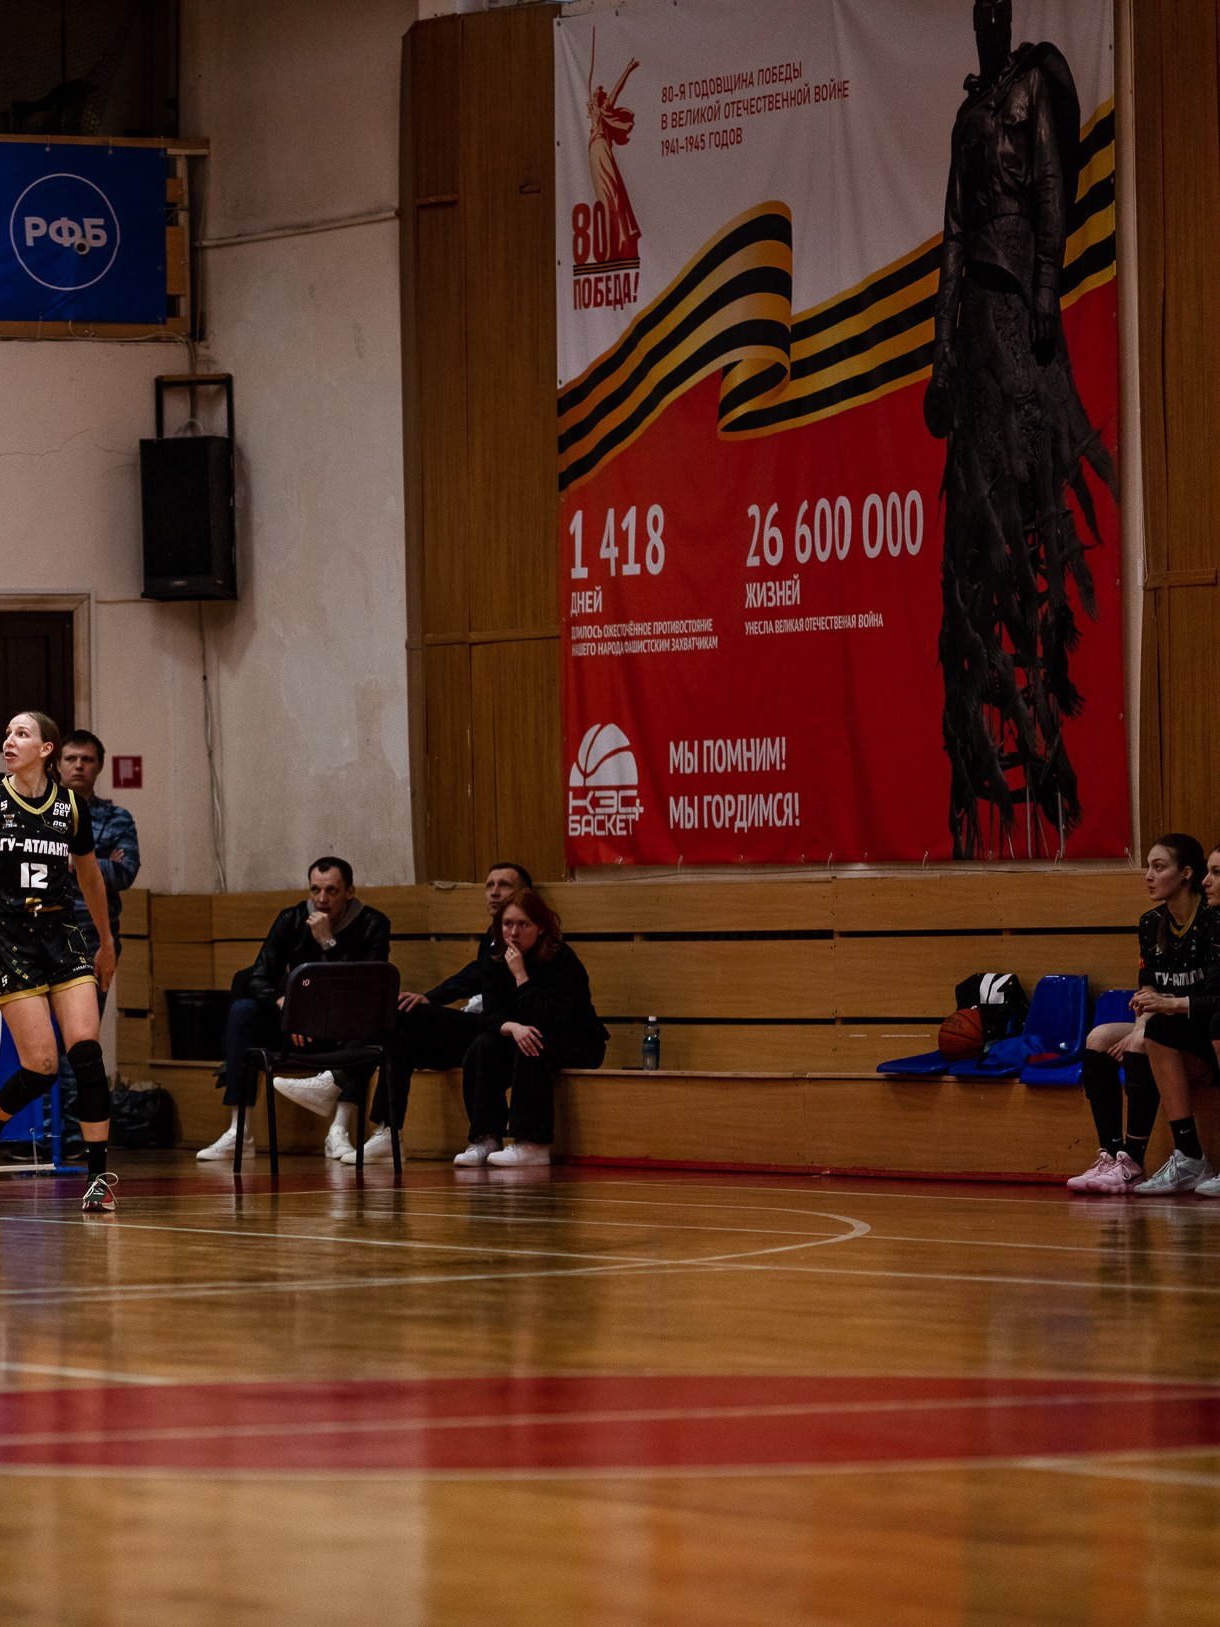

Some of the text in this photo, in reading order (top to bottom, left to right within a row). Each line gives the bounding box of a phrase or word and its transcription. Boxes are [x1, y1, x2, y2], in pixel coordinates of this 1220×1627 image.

[661, 61, 803, 104] 80-Я ГОДОВЩИНА ПОБЕДЫ
[661, 78, 851, 131] В ВЕЛИКОЙ ОТЕЧЕСТВЕННОЙ ВОЙНЕ
[708, 127, 744, 150] ГОДОВ
[24, 216, 108, 248] РФБ
[571, 200, 607, 265] 80
[573, 271, 640, 311] ПОБЕДА!
[569, 503, 666, 580] 1 418
[746, 489, 925, 567] 26 600 000
[570, 585, 603, 617] ДНЕЙ
[745, 573, 801, 609] ЖИЗНЕЙ
[653, 618, 713, 635] ПРОТИВОСТОЯНИЕ
[745, 611, 884, 636] УНЕСЛА ВЕЛИКАЯ ОТЕЧЕСТВЕННАЯ ВОЙНА
[598, 640, 625, 656] НАРОДА
[671, 635, 719, 652] ЗАХВАТЧИКАМ
[669, 736, 787, 775] МЫ ПОМНИМ!
[52, 809, 70, 818] BET
[54, 802, 71, 811] FON
[669, 792, 801, 834] МЫ ГОРДИМСЯ!
[568, 814, 635, 837] БАСКЕТ
[20, 862, 49, 889] 12
